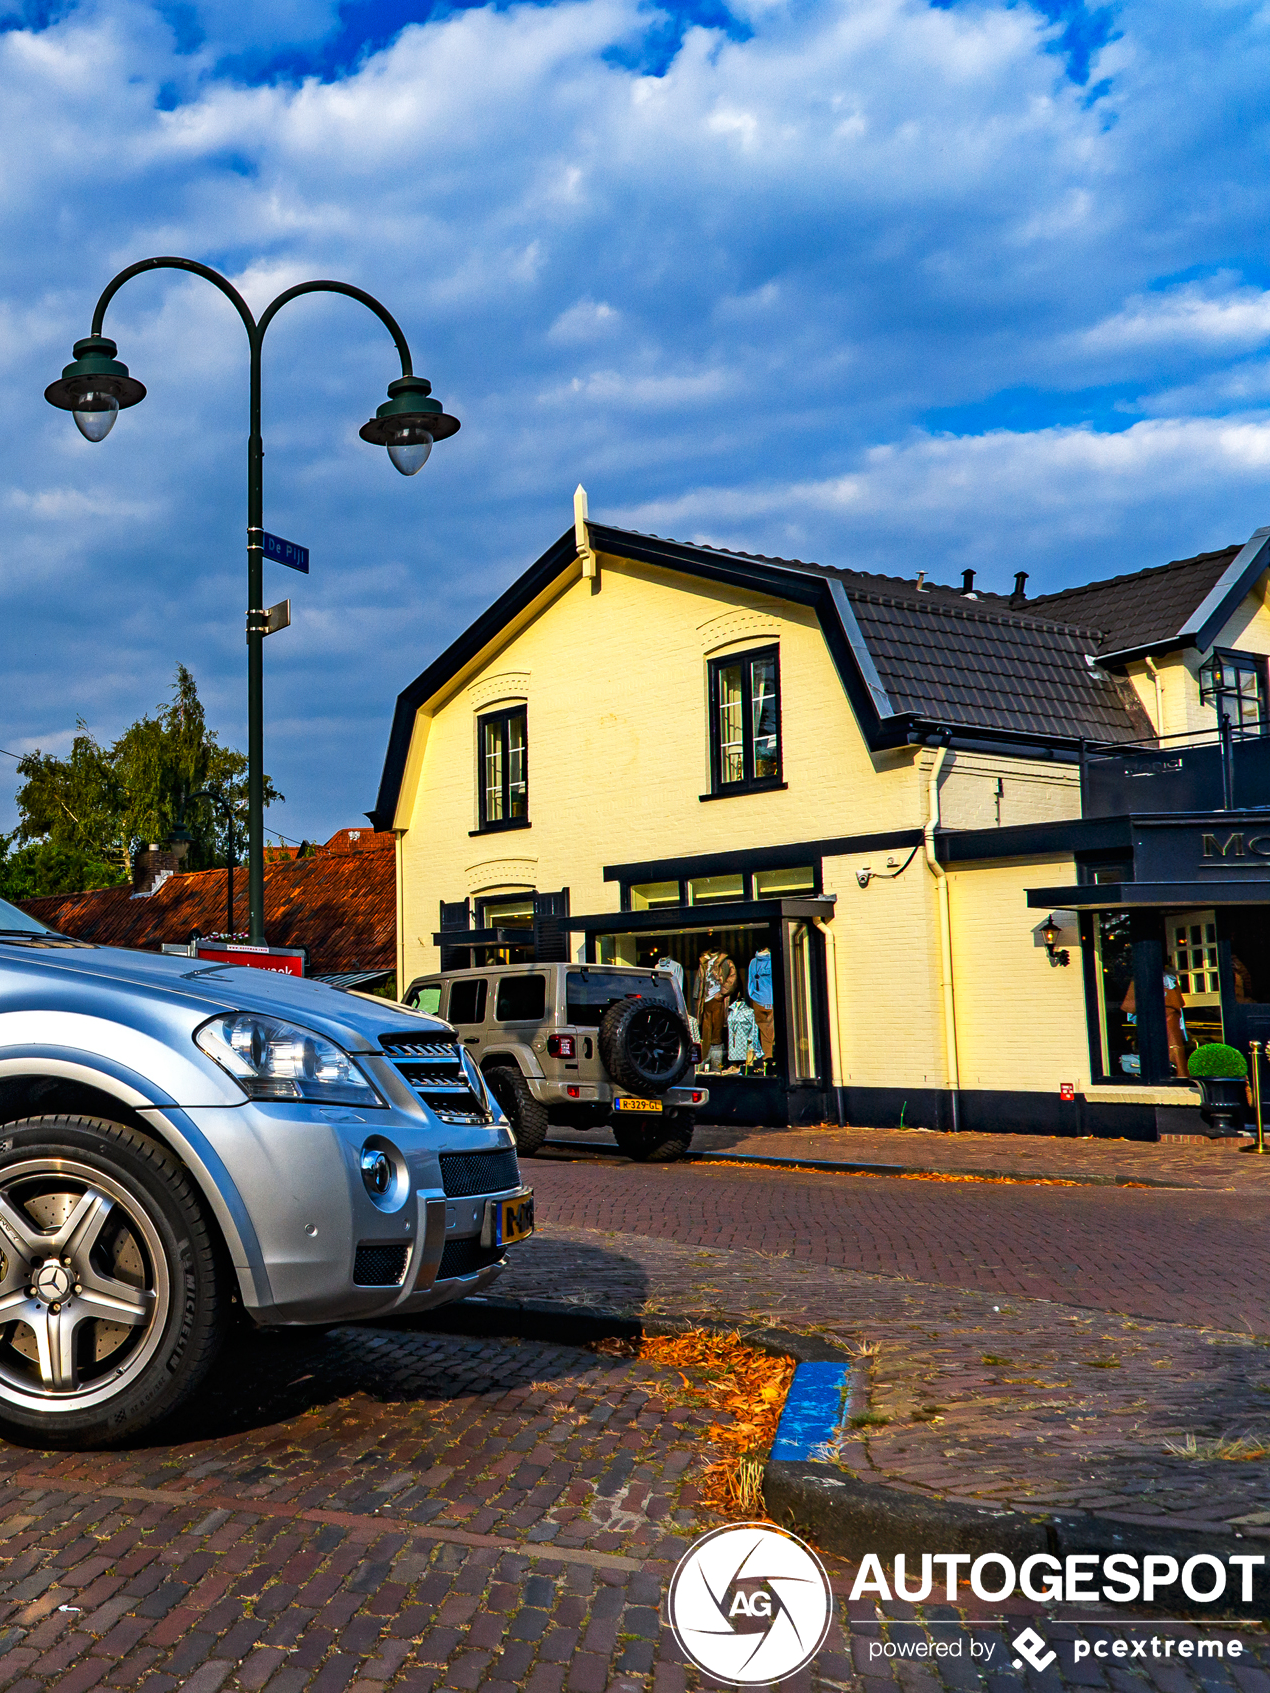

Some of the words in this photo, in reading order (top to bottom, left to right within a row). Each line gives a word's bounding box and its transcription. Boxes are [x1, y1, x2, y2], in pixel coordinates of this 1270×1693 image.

[268, 538, 281, 554] De
[286, 545, 304, 565] Pijl
[623, 1100, 659, 1110] R-329-GL
[169, 1274, 196, 1370] MICHELIN
